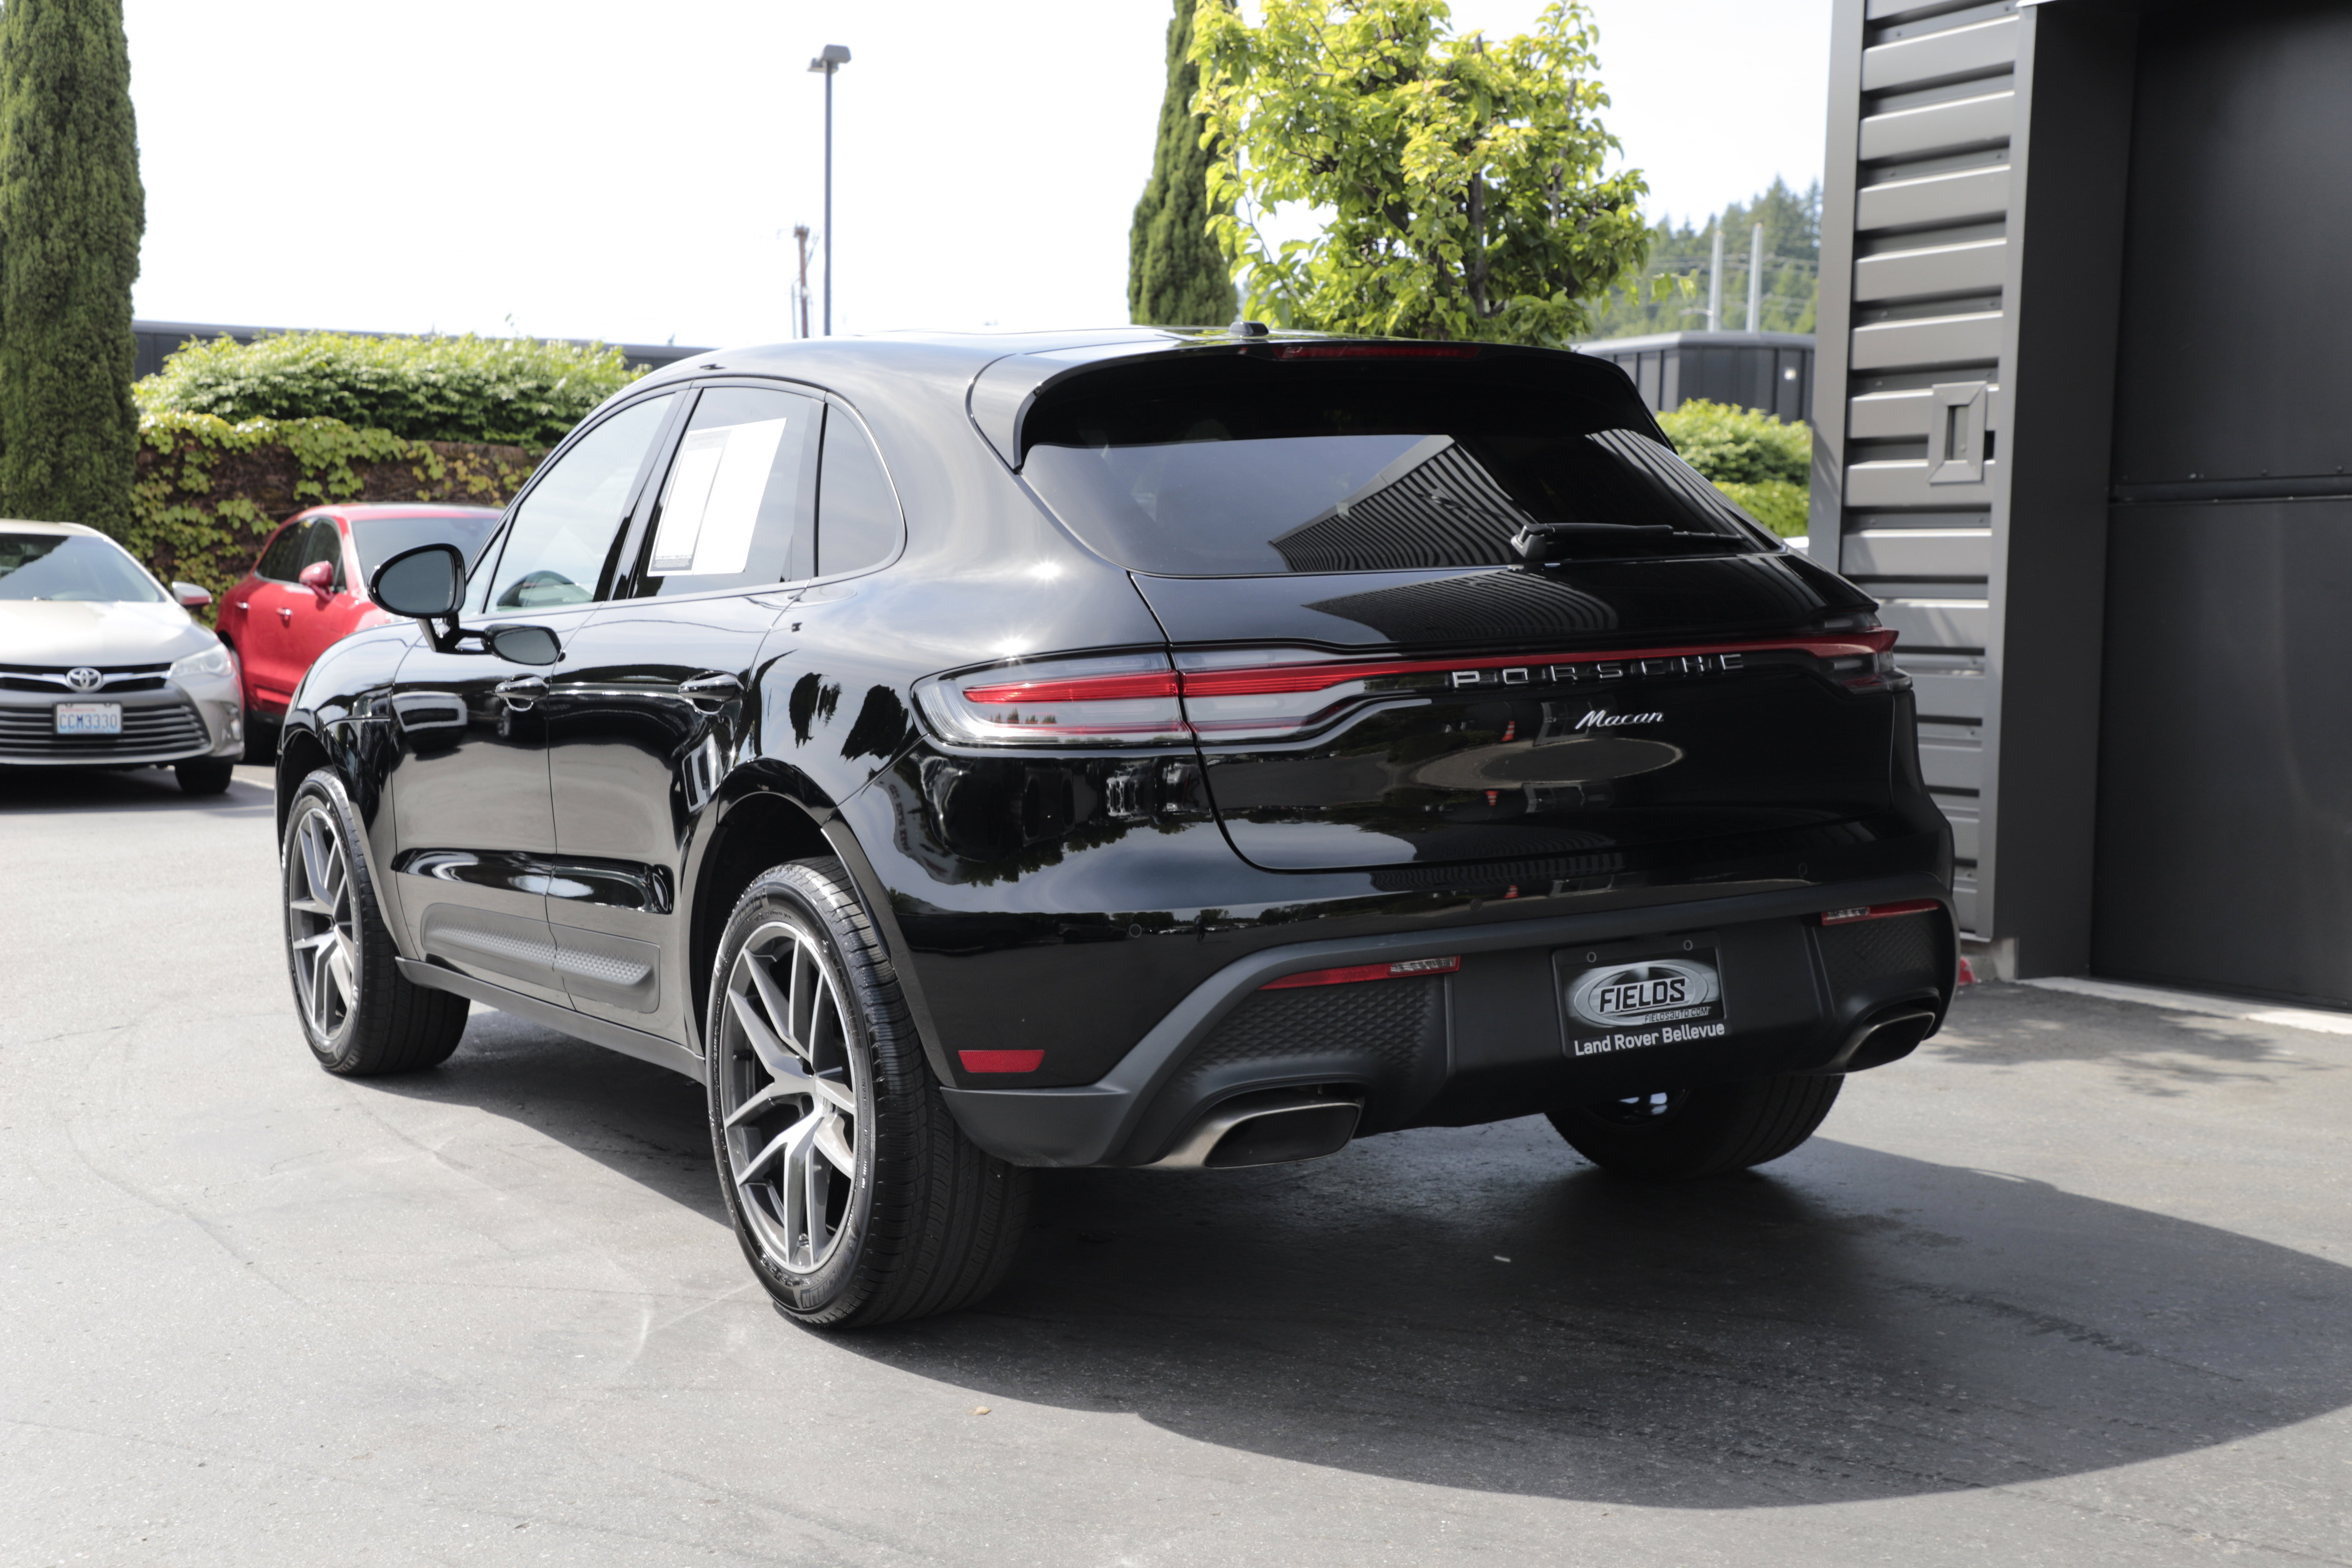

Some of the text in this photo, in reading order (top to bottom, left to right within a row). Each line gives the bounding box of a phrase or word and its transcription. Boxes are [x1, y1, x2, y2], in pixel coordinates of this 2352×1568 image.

[1451, 654, 1744, 688] PORSCHE
[59, 714, 117, 729] CCM3330
[1575, 710, 1664, 730] Macan
[1599, 978, 1686, 1013] FIELDS
[1574, 1022, 1725, 1056] Land Rover Bellevue
